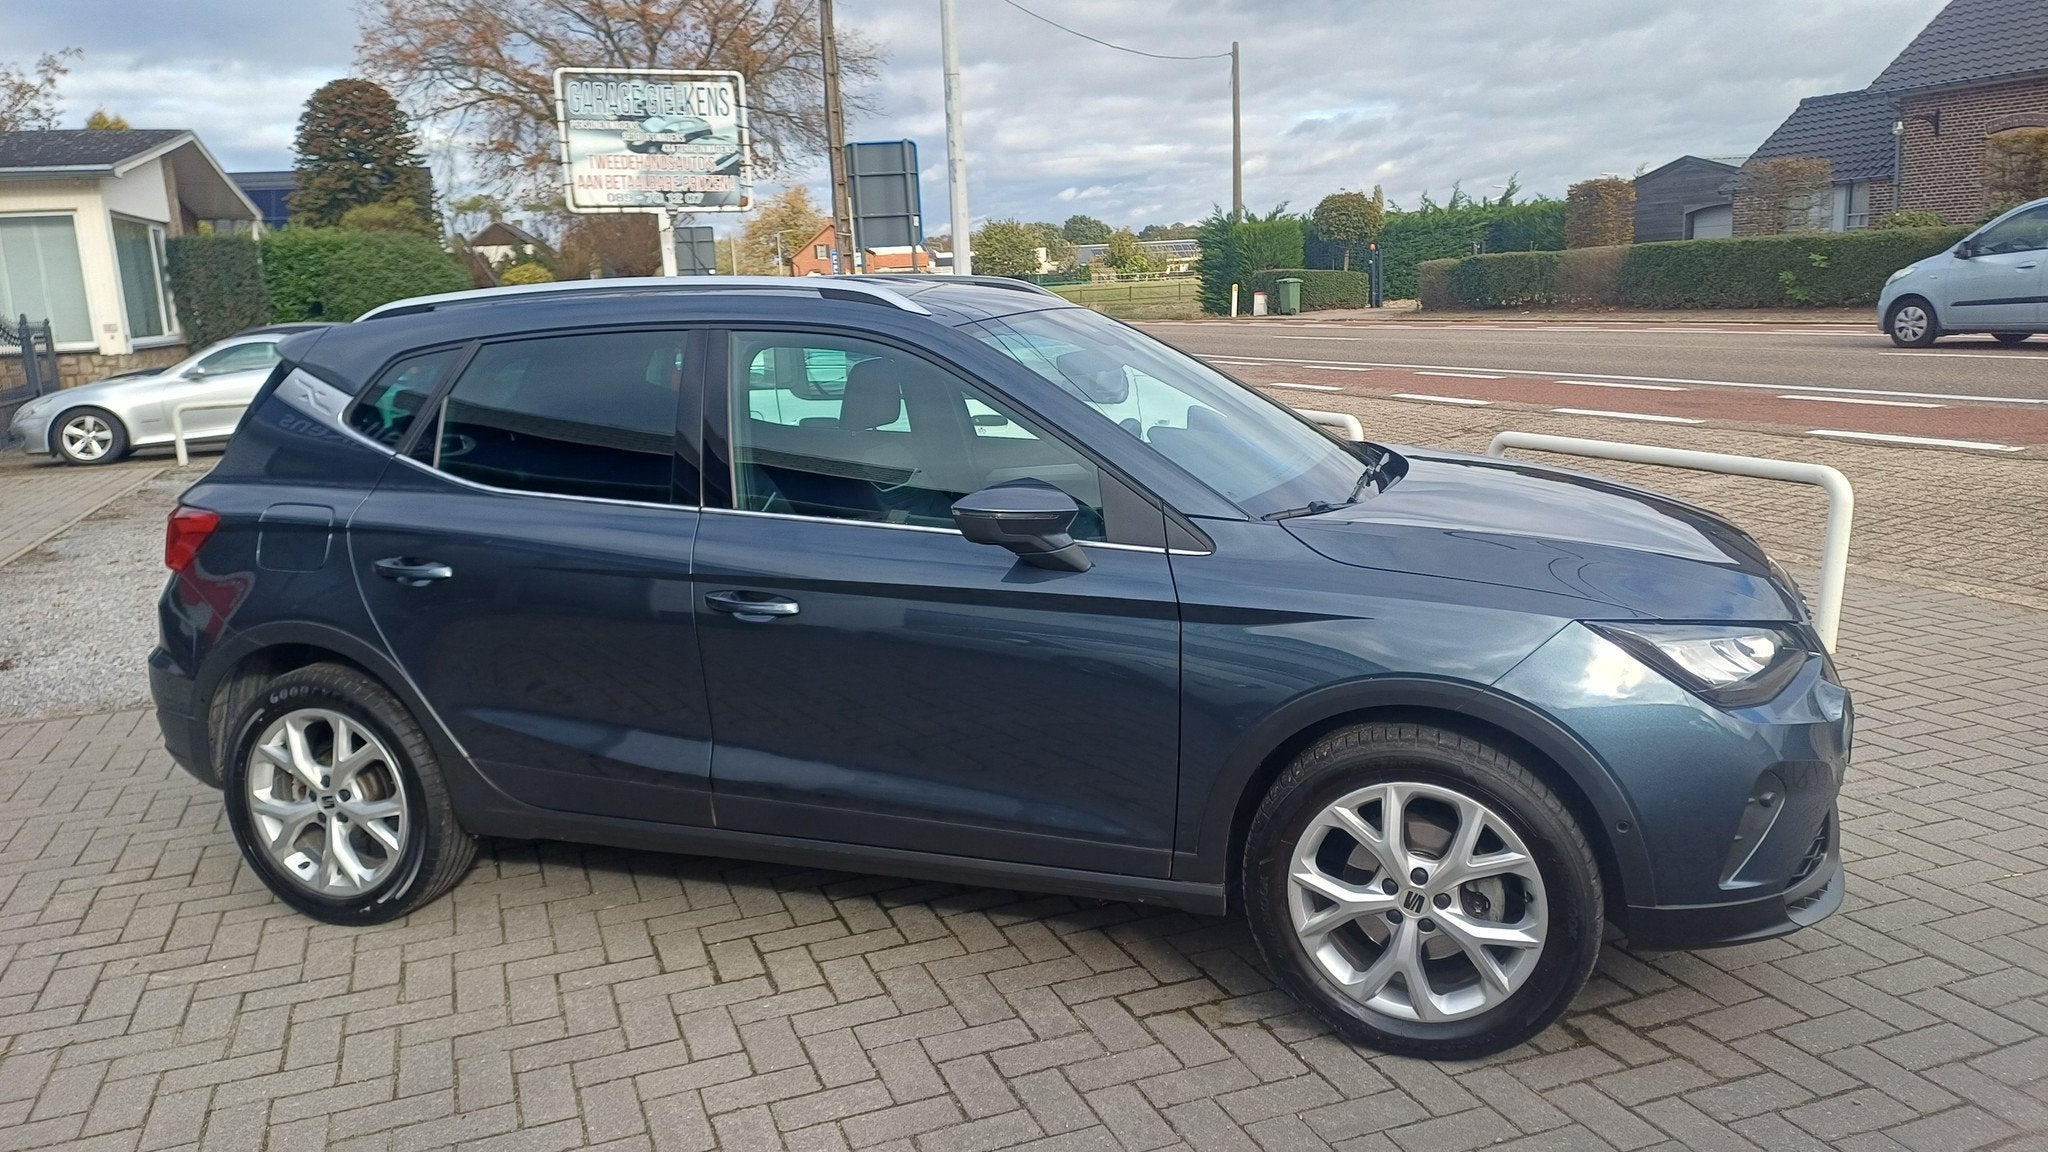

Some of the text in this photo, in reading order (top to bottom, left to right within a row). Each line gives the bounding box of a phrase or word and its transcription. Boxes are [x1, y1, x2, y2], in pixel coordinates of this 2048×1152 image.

[568, 81, 730, 117] GARAGE GIELKENS
[577, 174, 603, 189] AAN
[605, 174, 682, 191] BETAALBARE
